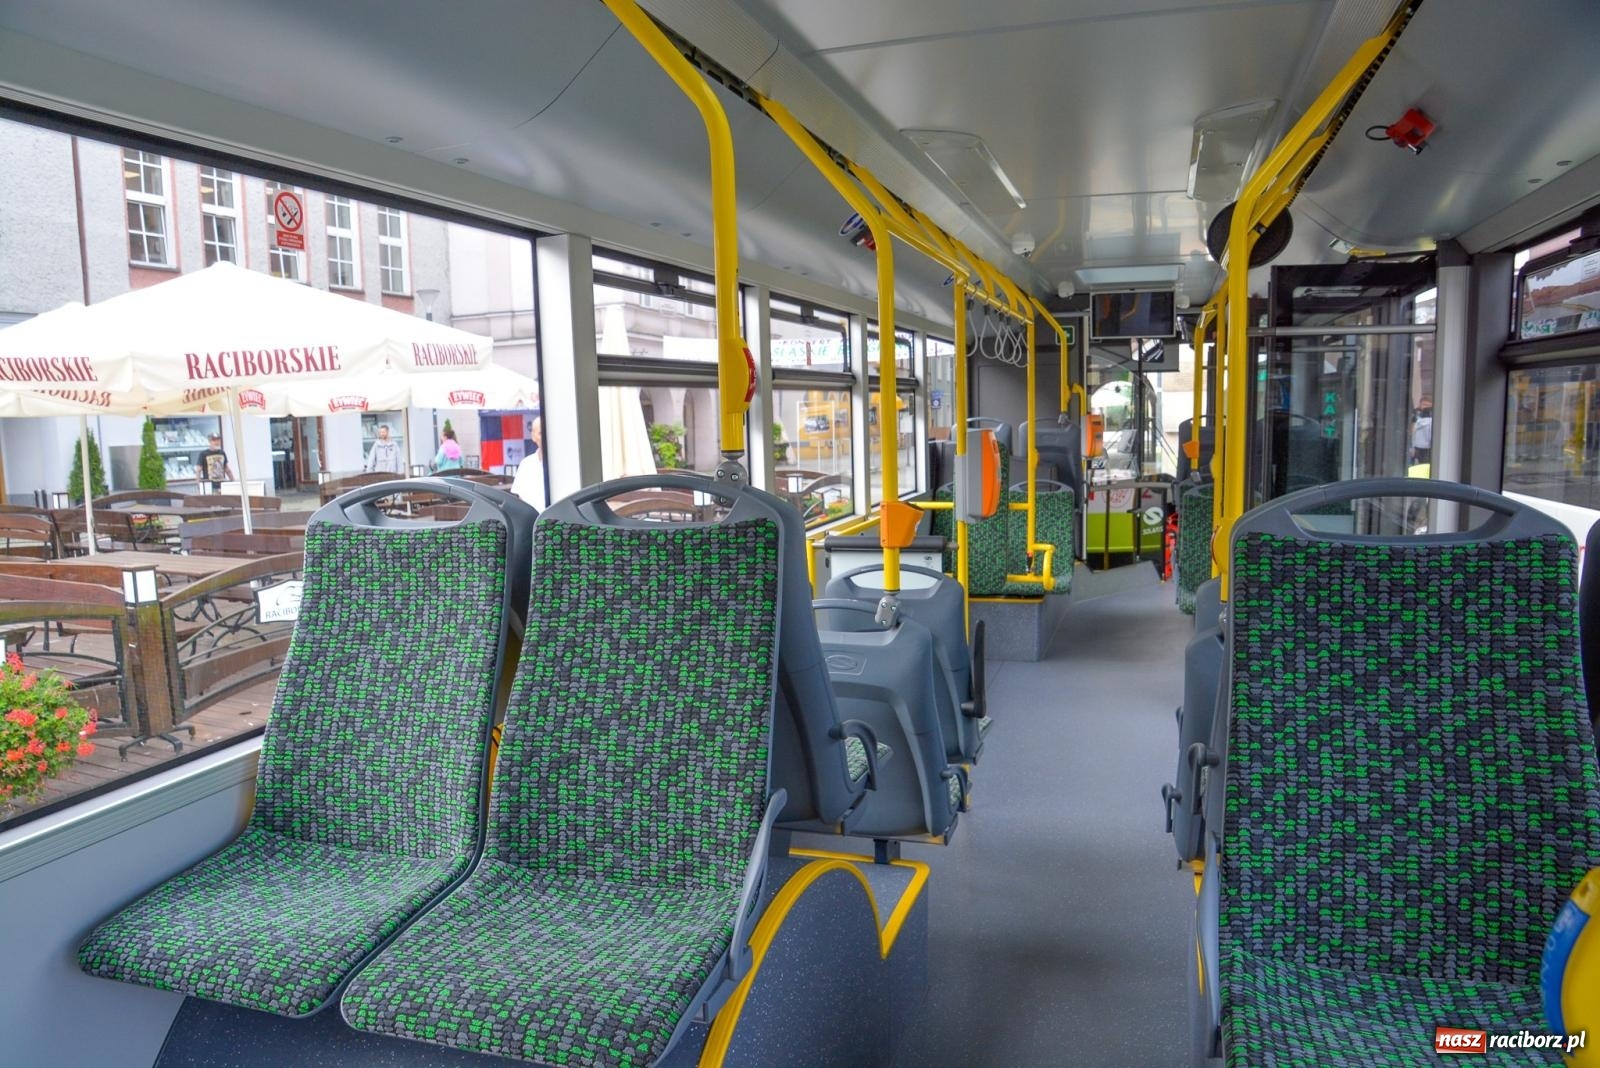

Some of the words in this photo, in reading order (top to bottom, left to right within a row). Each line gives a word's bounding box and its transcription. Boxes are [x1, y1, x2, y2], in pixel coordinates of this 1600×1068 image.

[184, 345, 341, 380] RACIBORSKIE
[412, 342, 478, 366] RACIBORSKIE
[0, 356, 98, 382] CIBORSKIE
